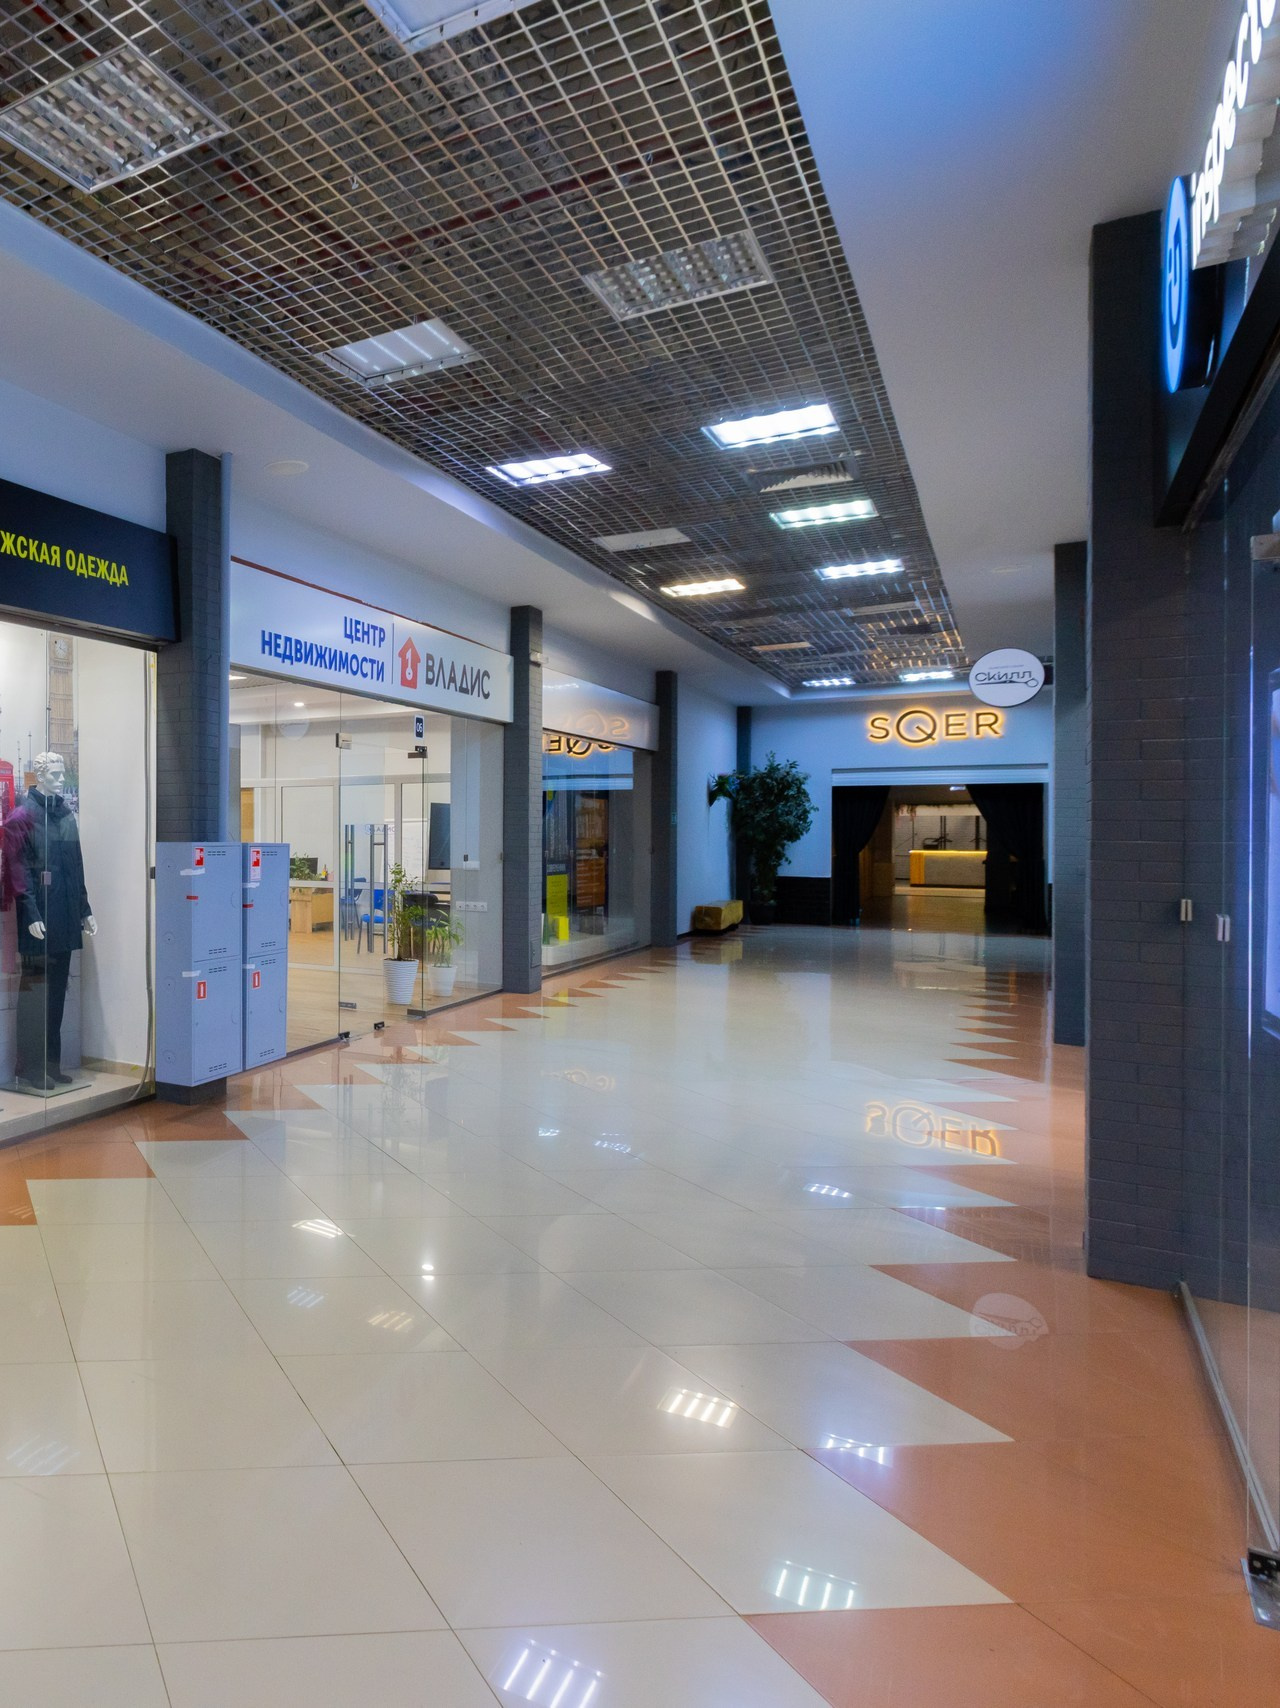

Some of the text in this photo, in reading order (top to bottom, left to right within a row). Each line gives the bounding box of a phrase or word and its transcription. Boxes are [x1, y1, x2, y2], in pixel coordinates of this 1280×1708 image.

[1191, 0, 1277, 270] inspect
[65, 550, 129, 587] ОДЕЖДА
[343, 616, 386, 648] ЦЕНТР
[260, 630, 385, 683] НЕДВИЖИМОСТИ
[425, 652, 491, 700] ВЛАДИС
[869, 709, 1001, 744] SQER
